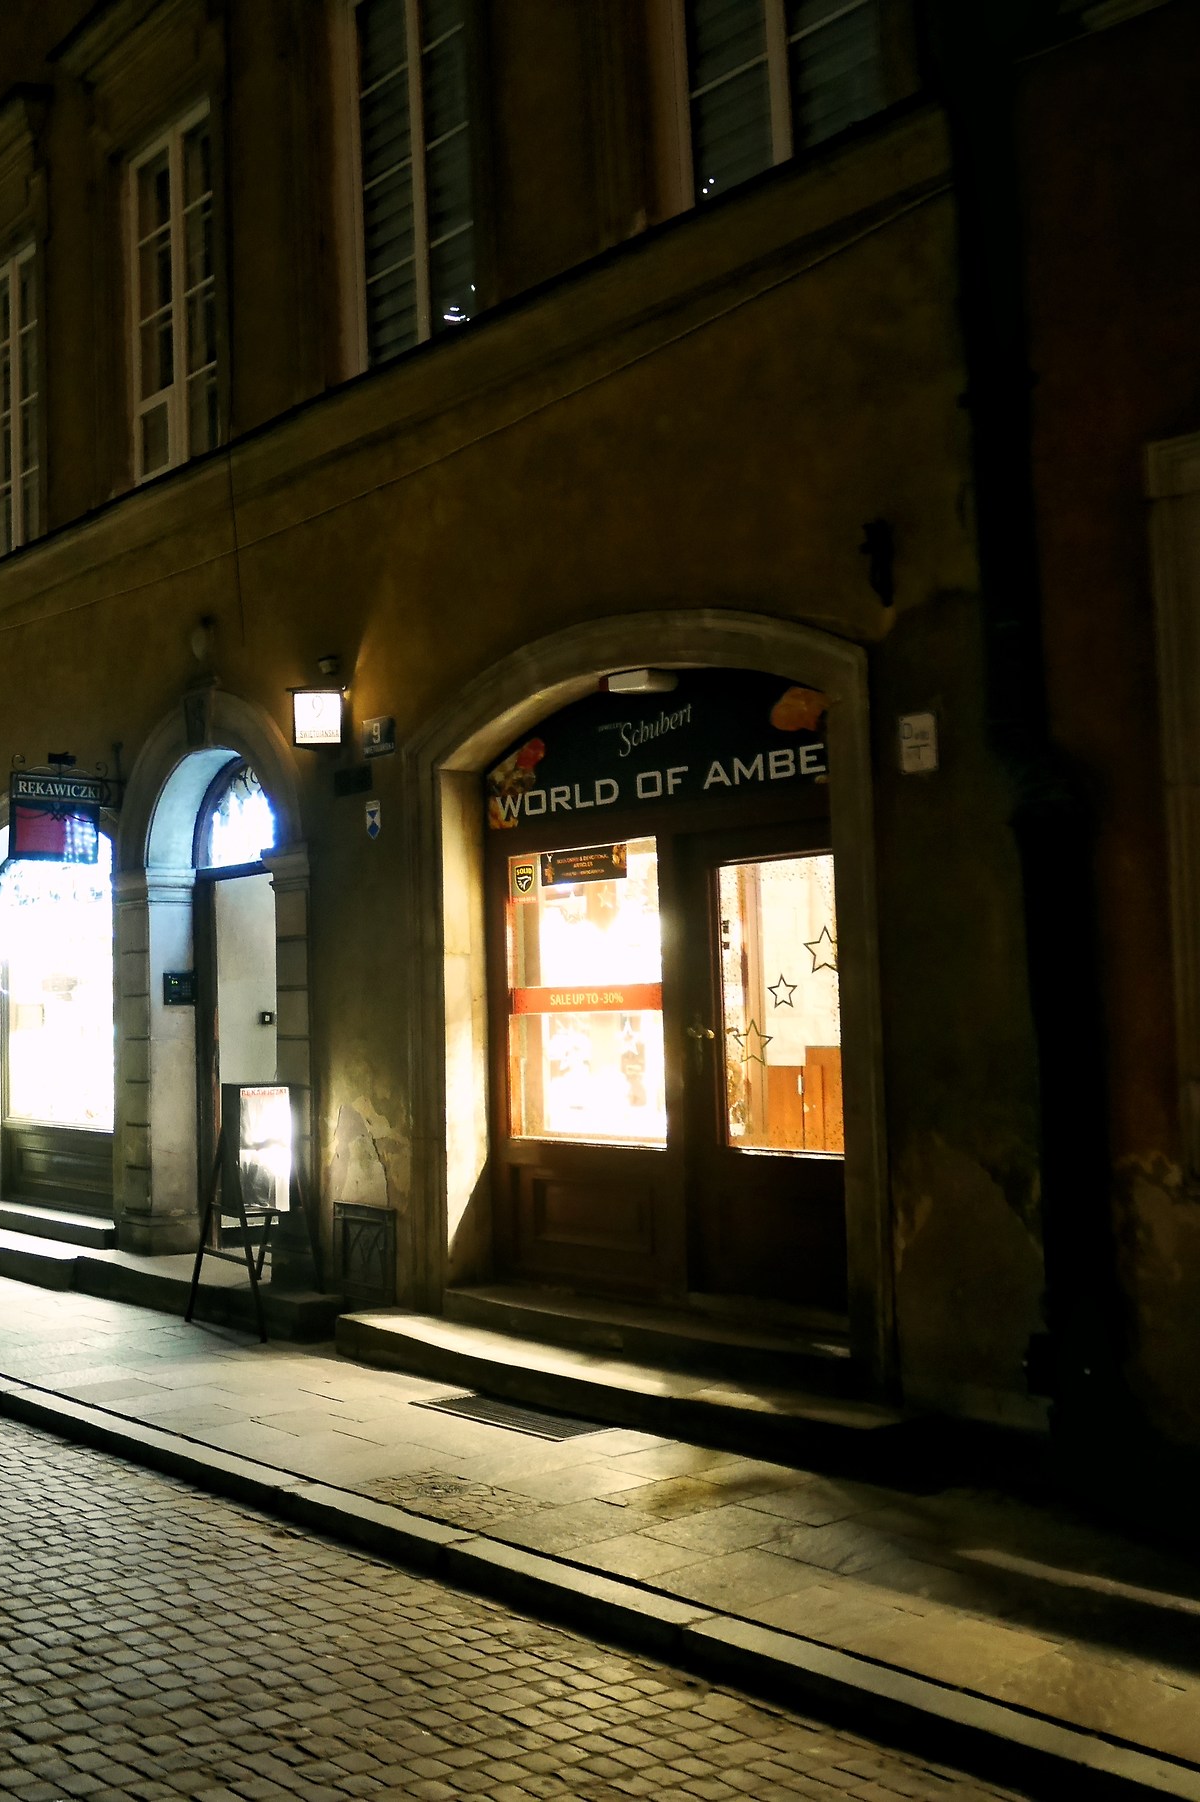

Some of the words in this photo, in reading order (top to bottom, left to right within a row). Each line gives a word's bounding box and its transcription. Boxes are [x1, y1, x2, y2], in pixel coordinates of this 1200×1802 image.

[312, 694, 325, 719] 9
[372, 722, 381, 744] 9
[618, 702, 693, 758] Schubert
[18, 780, 101, 798] RĘKAWICZKI
[495, 777, 620, 820] WORLD
[636, 766, 689, 800] OF
[516, 867, 533, 876] SOLID
[550, 993, 572, 1006] SALE
[572, 993, 585, 1005] UP
[585, 992, 599, 1004] TO
[600, 991, 624, 1004] -30%
